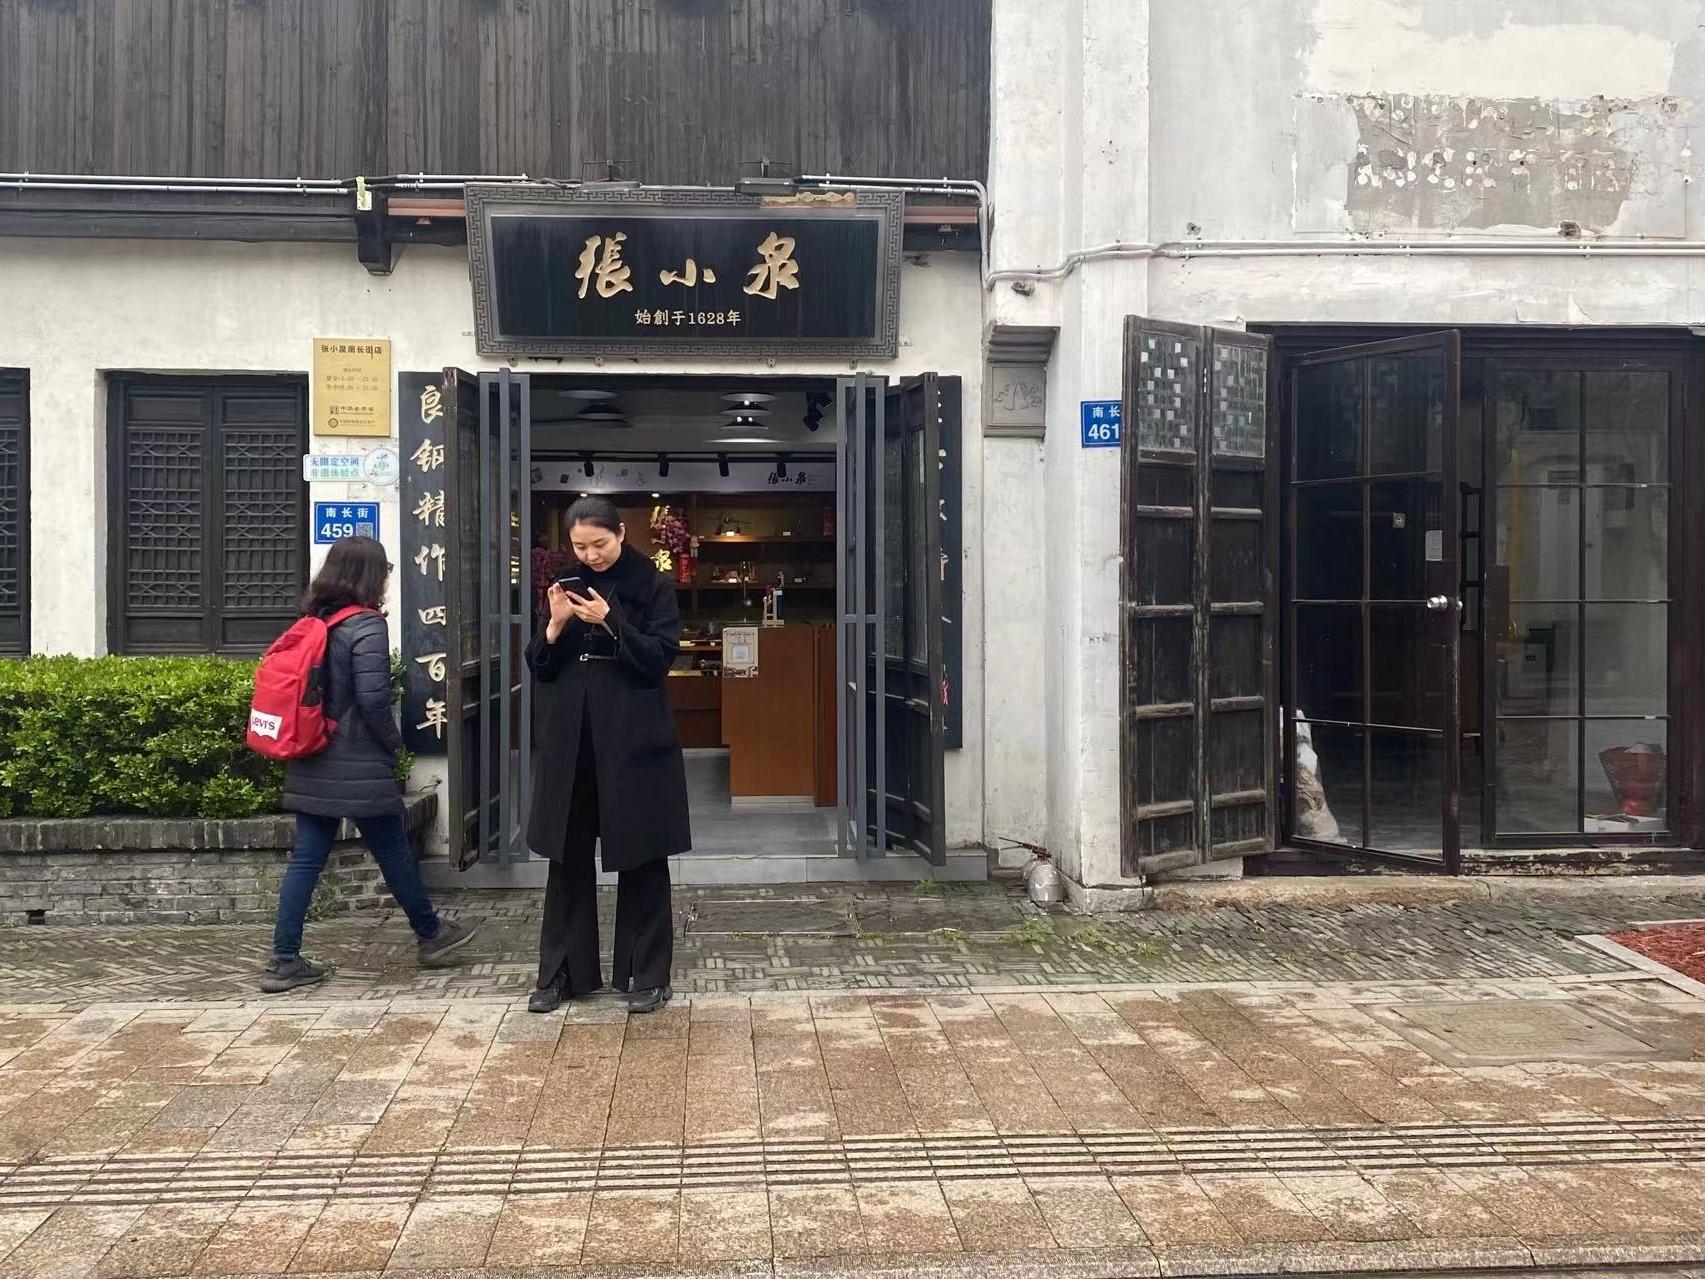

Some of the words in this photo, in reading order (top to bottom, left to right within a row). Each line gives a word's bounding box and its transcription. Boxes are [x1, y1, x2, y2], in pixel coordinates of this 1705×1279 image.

[575, 231, 799, 299] 張小泉
[634, 309, 742, 325] 始創于1628年
[319, 344, 382, 355] 张小泉南长街店
[1088, 423, 1120, 440] 461
[325, 506, 369, 519] 南长街
[320, 523, 354, 539] 459
